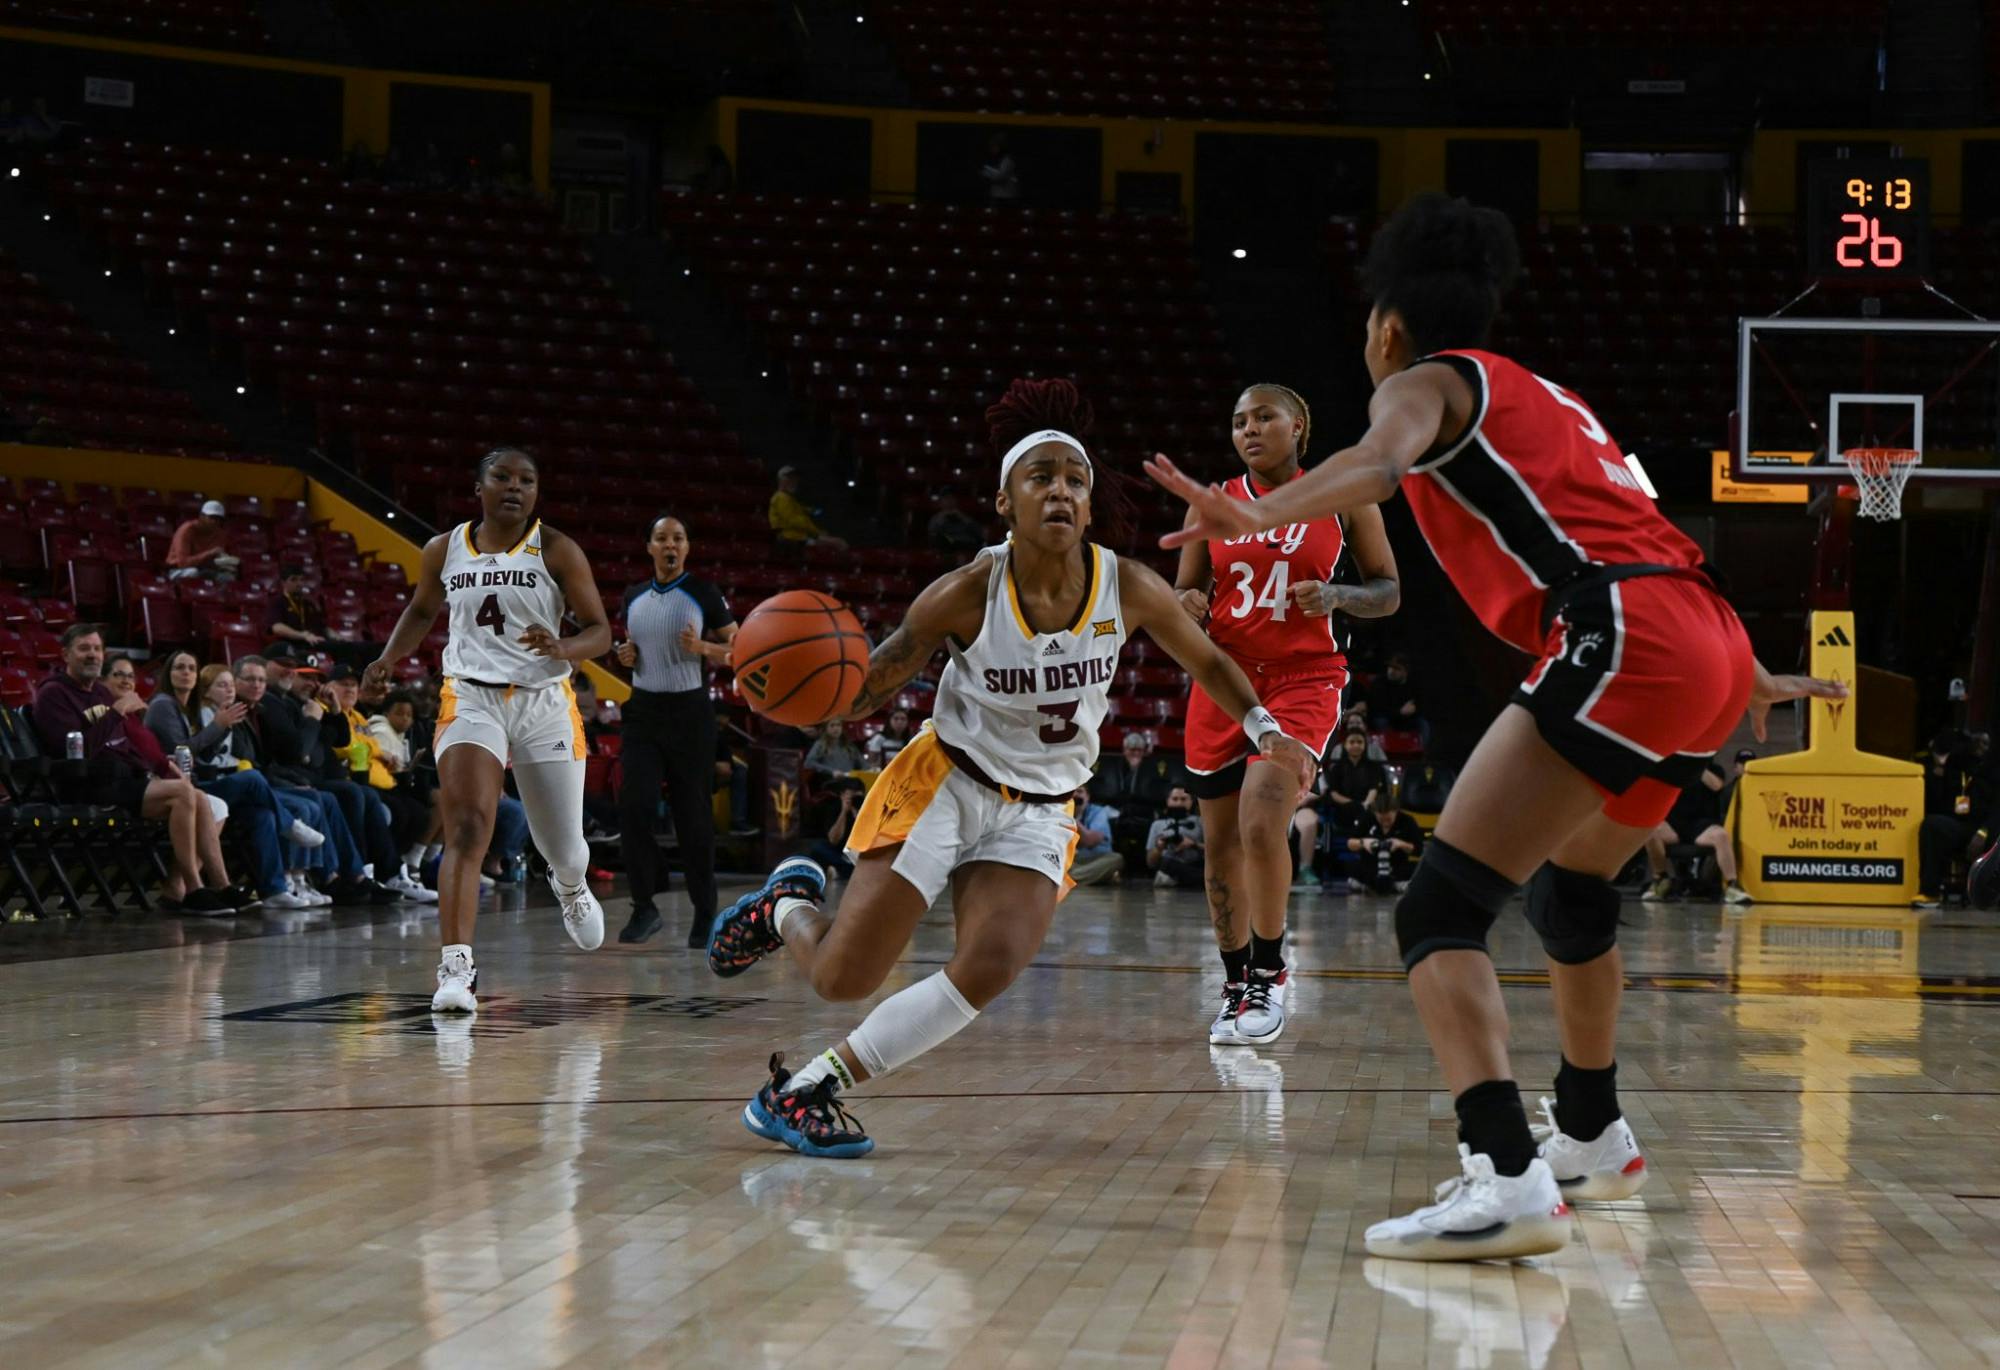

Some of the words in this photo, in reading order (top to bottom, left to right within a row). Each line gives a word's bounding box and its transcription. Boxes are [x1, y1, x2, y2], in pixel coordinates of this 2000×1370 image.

[1846, 179, 1911, 209] 9:13
[1836, 213, 1902, 268] 26
[450, 572, 477, 592] SUN
[482, 570, 537, 589] DEVILS
[1229, 560, 1292, 622] 34
[476, 594, 506, 636] 4
[984, 668, 1037, 695] SUN
[1044, 656, 1114, 692] DEVILS
[1037, 699, 1081, 744] 3
[1785, 797, 1825, 814] SUN
[1841, 803, 1908, 818] Together
[1779, 815, 1827, 829] ANGEL
[1841, 820, 1863, 830] we
[1866, 818, 1896, 830] win.
[1788, 838, 1818, 850] Join
[1822, 839, 1861, 853] today
[1864, 840, 1878, 851] at
[1768, 862, 1897, 878] SUNANGELS.ORG
